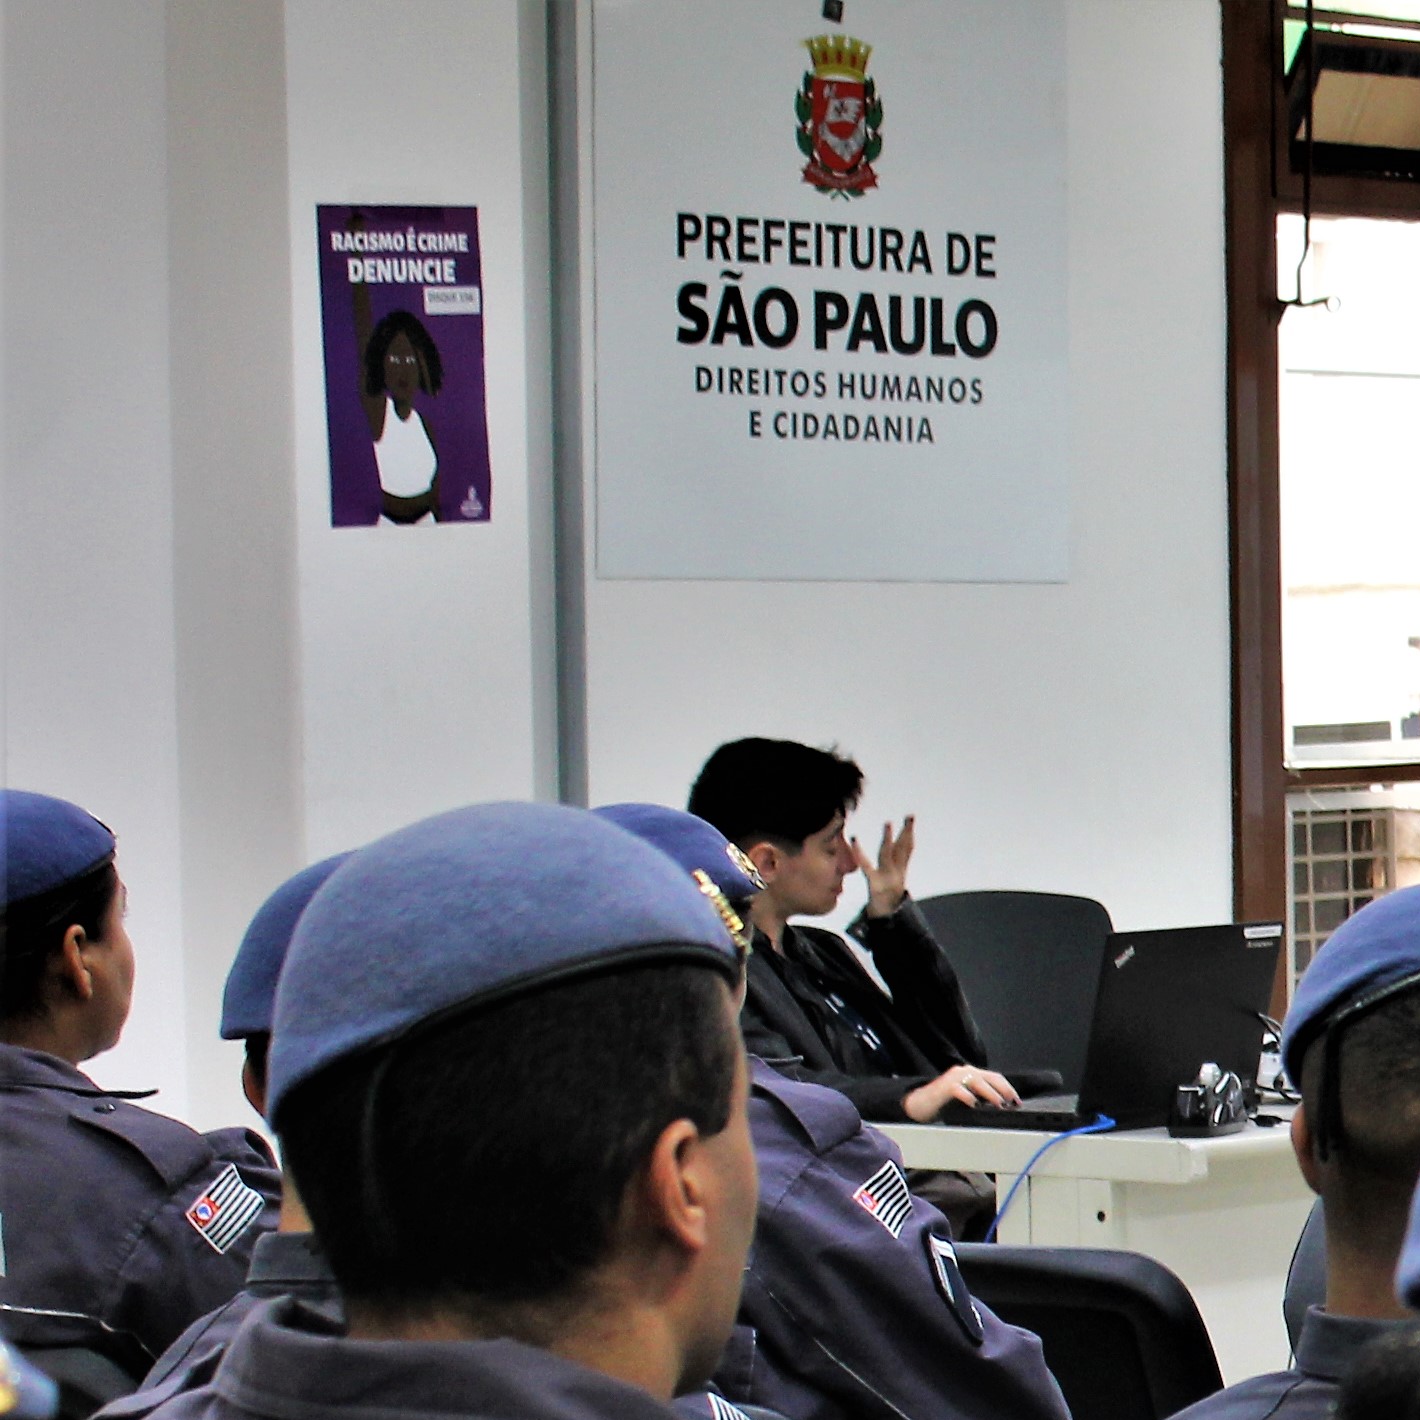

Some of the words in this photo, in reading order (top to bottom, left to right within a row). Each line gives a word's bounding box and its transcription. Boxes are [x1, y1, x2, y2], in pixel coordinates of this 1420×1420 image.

[331, 232, 404, 251] RACISMO
[406, 227, 417, 251] É
[418, 233, 468, 252] CRIME
[676, 212, 932, 274] PREFEITURA
[947, 233, 996, 278] DE
[348, 258, 455, 283] DENUNCIE
[677, 270, 798, 349] SÃO
[814, 291, 998, 358] PAULO
[696, 366, 826, 398] DIREITOS
[839, 373, 982, 404] HUMANOS
[750, 411, 761, 437] E
[773, 412, 933, 442] CIDADANIA
